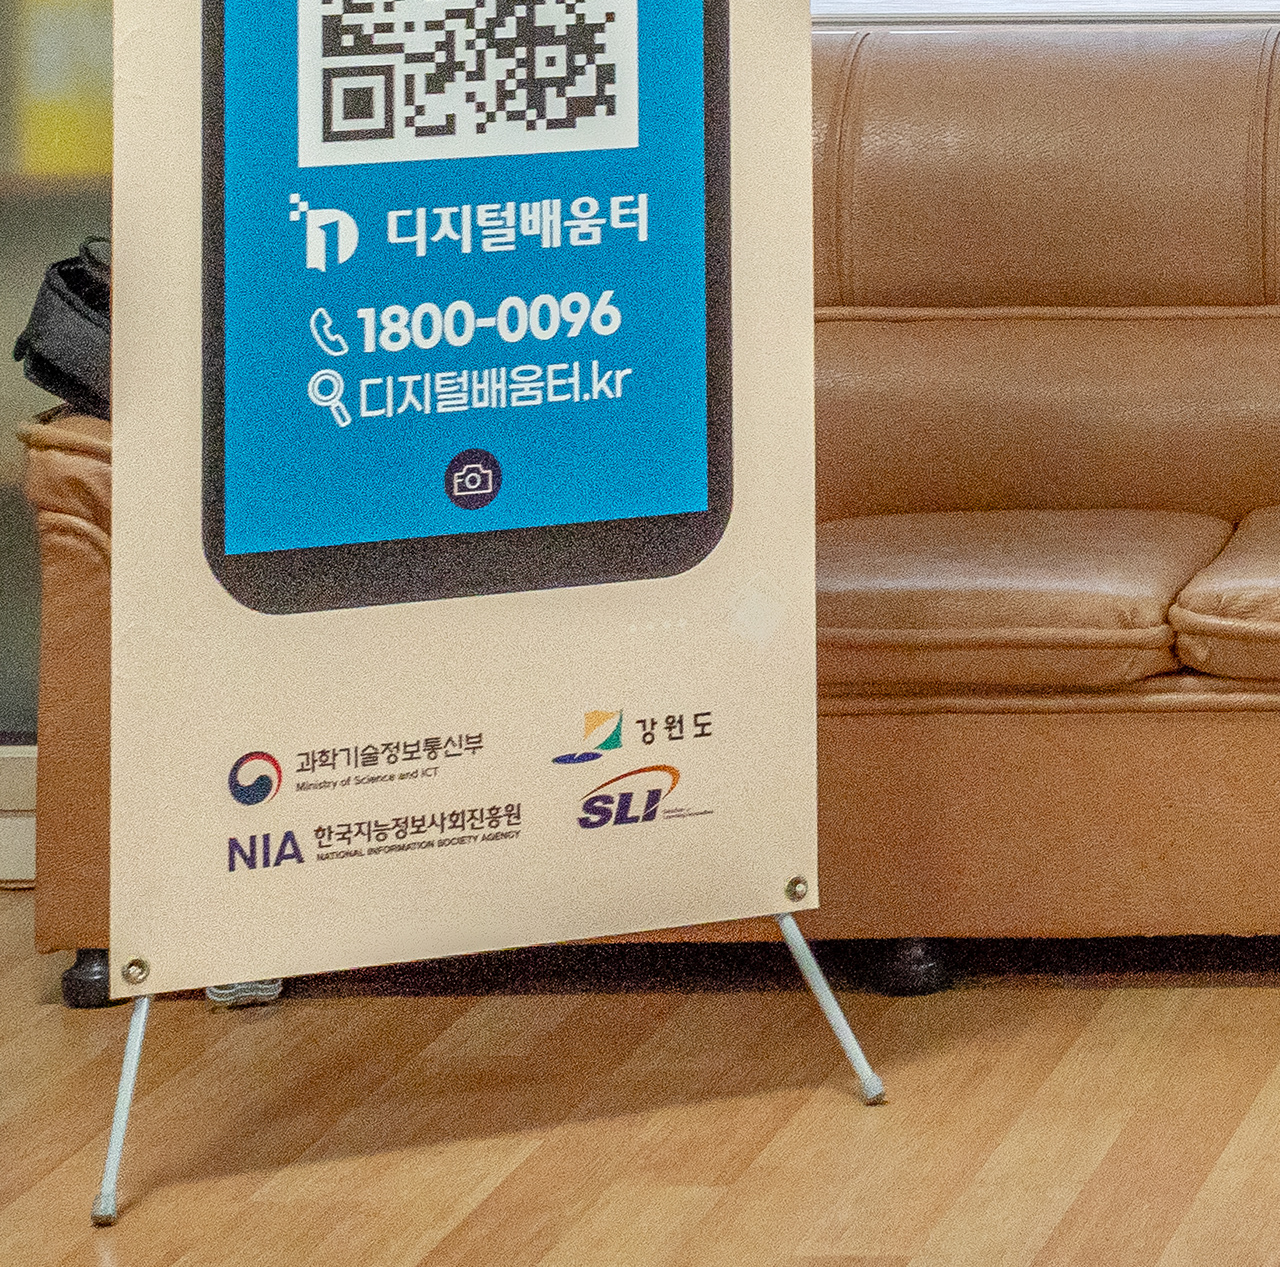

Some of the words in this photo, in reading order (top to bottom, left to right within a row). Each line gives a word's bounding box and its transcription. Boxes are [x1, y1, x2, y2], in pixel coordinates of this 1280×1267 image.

[386, 192, 650, 257] 디지털배움터
[356, 290, 623, 354] 1800-0096
[359, 359, 632, 418] 디지털배움터.kr
[635, 711, 713, 746] 강원도
[295, 732, 485, 775] 과학기술정보통신부
[295, 777, 338, 793] Ministry
[340, 775, 352, 789] of
[353, 771, 397, 787] Science
[398, 768, 420, 782] and
[420, 765, 440, 780] ICT
[313, 802, 523, 849] 한국지능정보사회진흥원
[576, 787, 663, 831] SLI
[227, 830, 305, 874] NIA
[316, 847, 366, 863] NATIONAL
[367, 838, 435, 859] INFORMATION
[437, 833, 479, 849] SOCIETY
[481, 828, 522, 844] AGENCY
